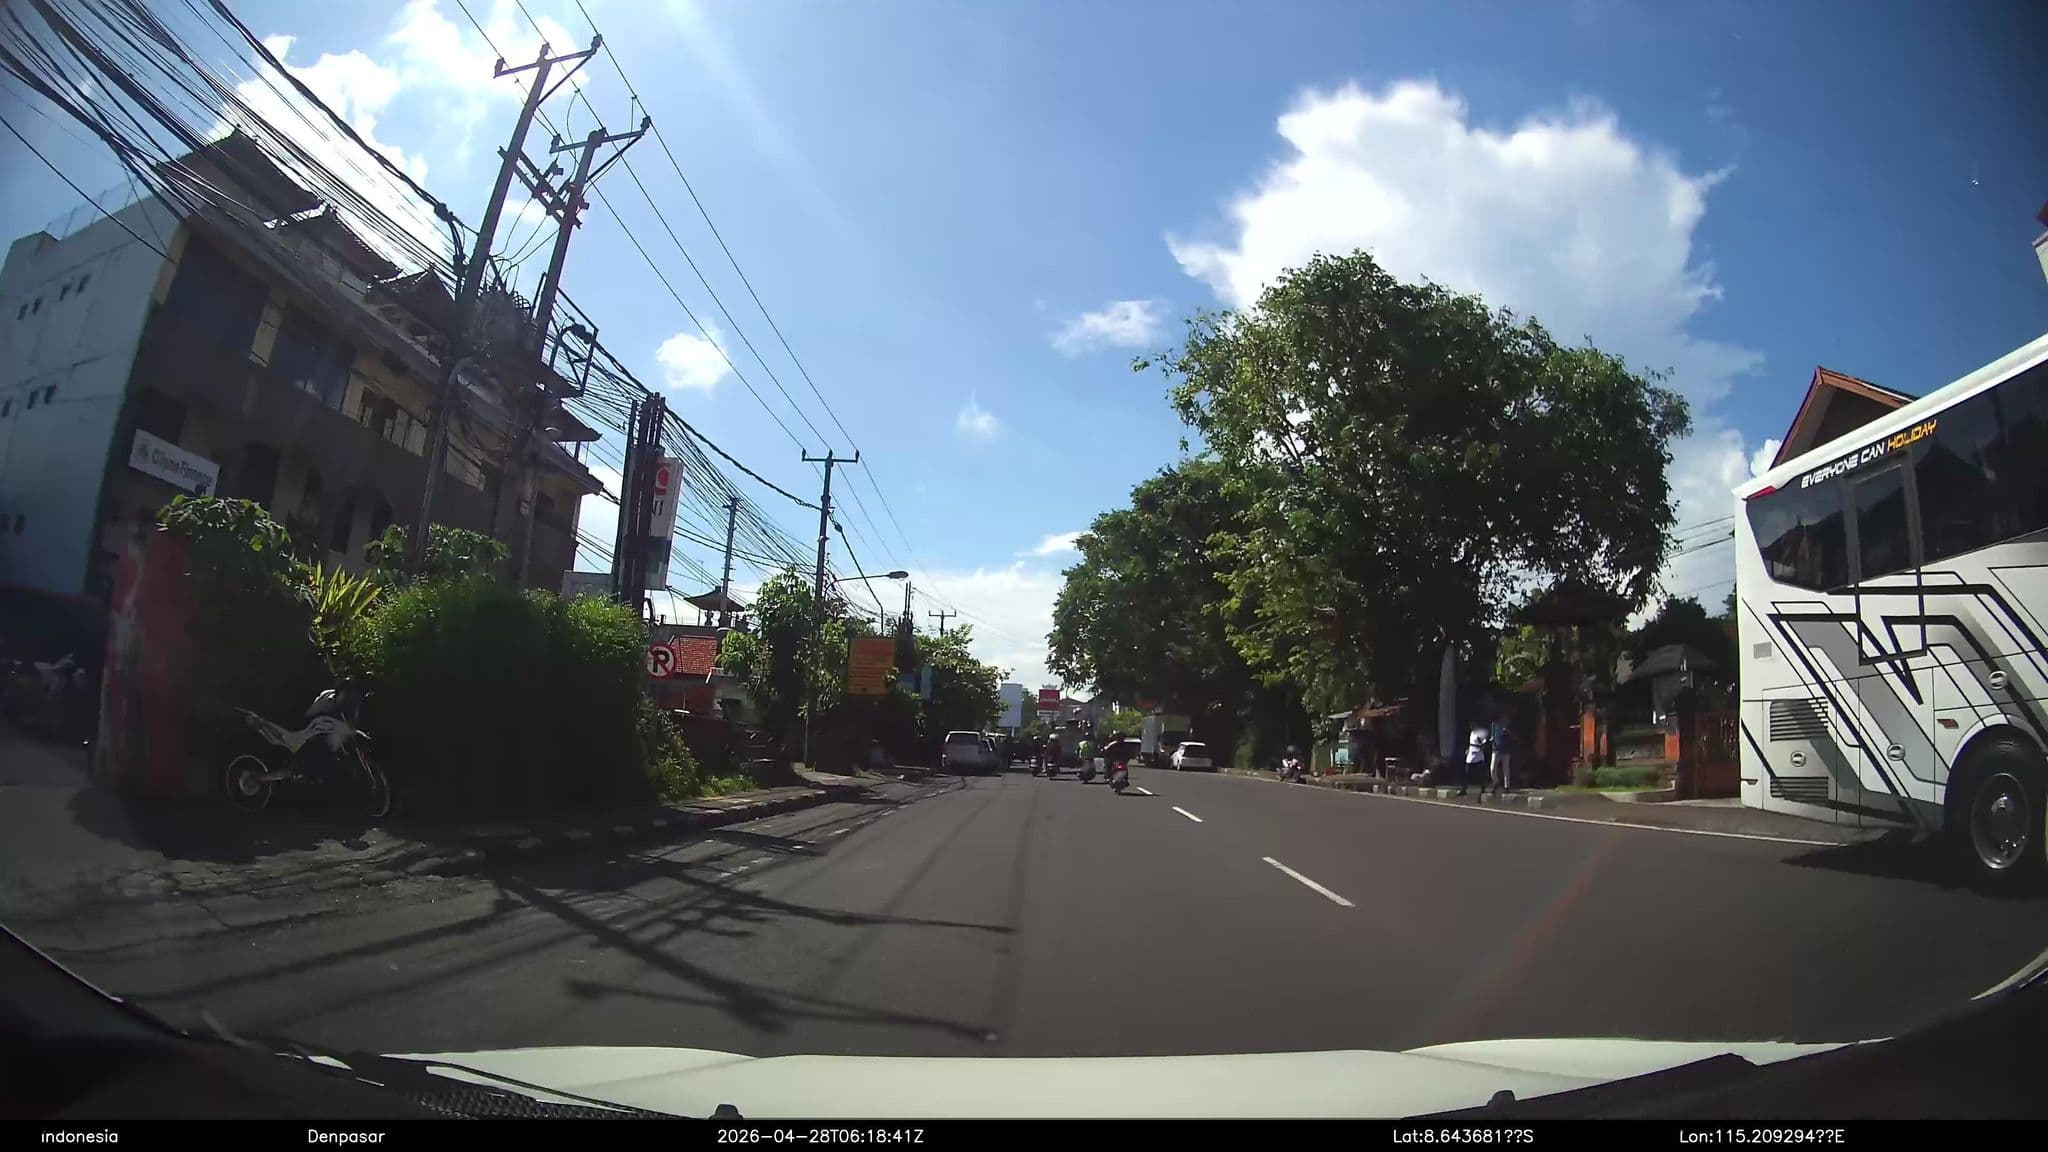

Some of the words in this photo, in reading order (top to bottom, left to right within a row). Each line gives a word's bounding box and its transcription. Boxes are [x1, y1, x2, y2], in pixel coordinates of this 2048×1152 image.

[1801, 454, 1859, 489] EVERYONE
[1860, 442, 1885, 464] CAN
[1886, 420, 1937, 452] HOLIDAY
